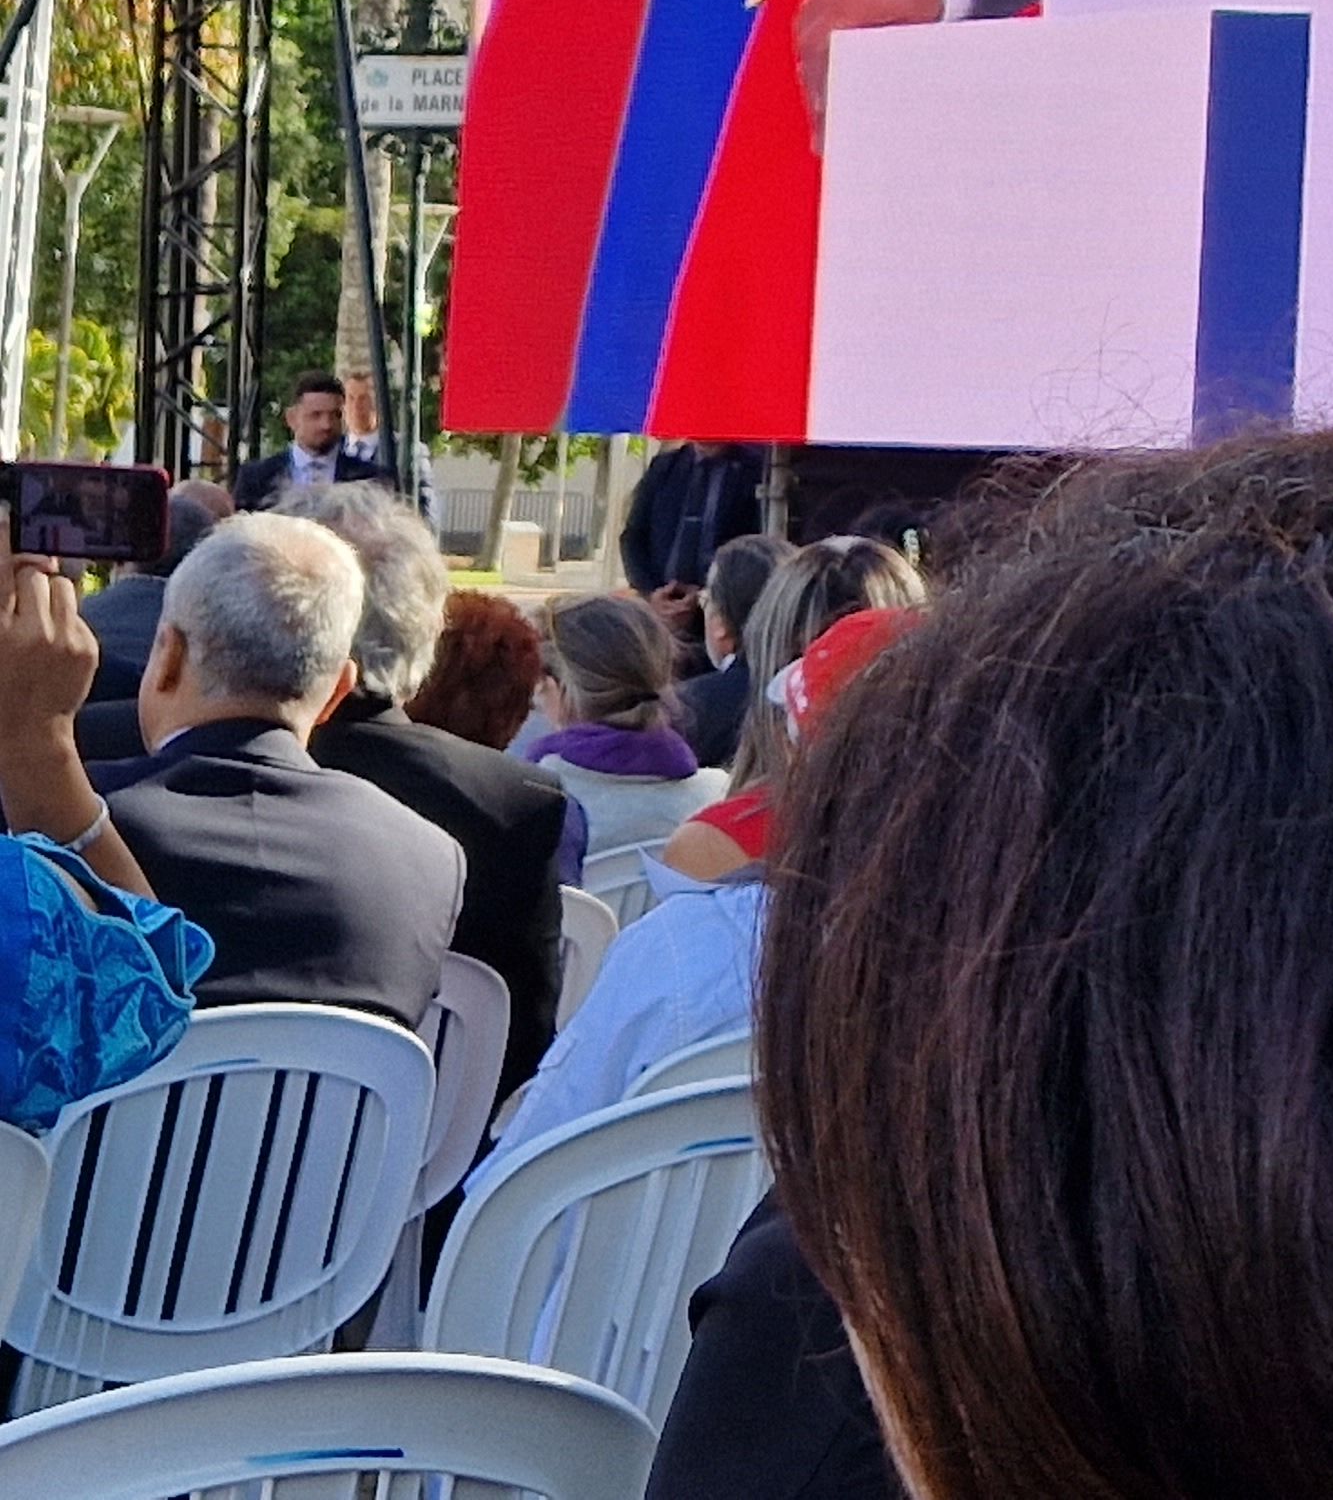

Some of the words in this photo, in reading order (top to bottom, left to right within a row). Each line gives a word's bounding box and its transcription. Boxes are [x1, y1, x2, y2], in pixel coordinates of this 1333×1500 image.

[412, 68, 462, 86] PLACE
[361, 95, 379, 114] de
[389, 95, 403, 112] la
